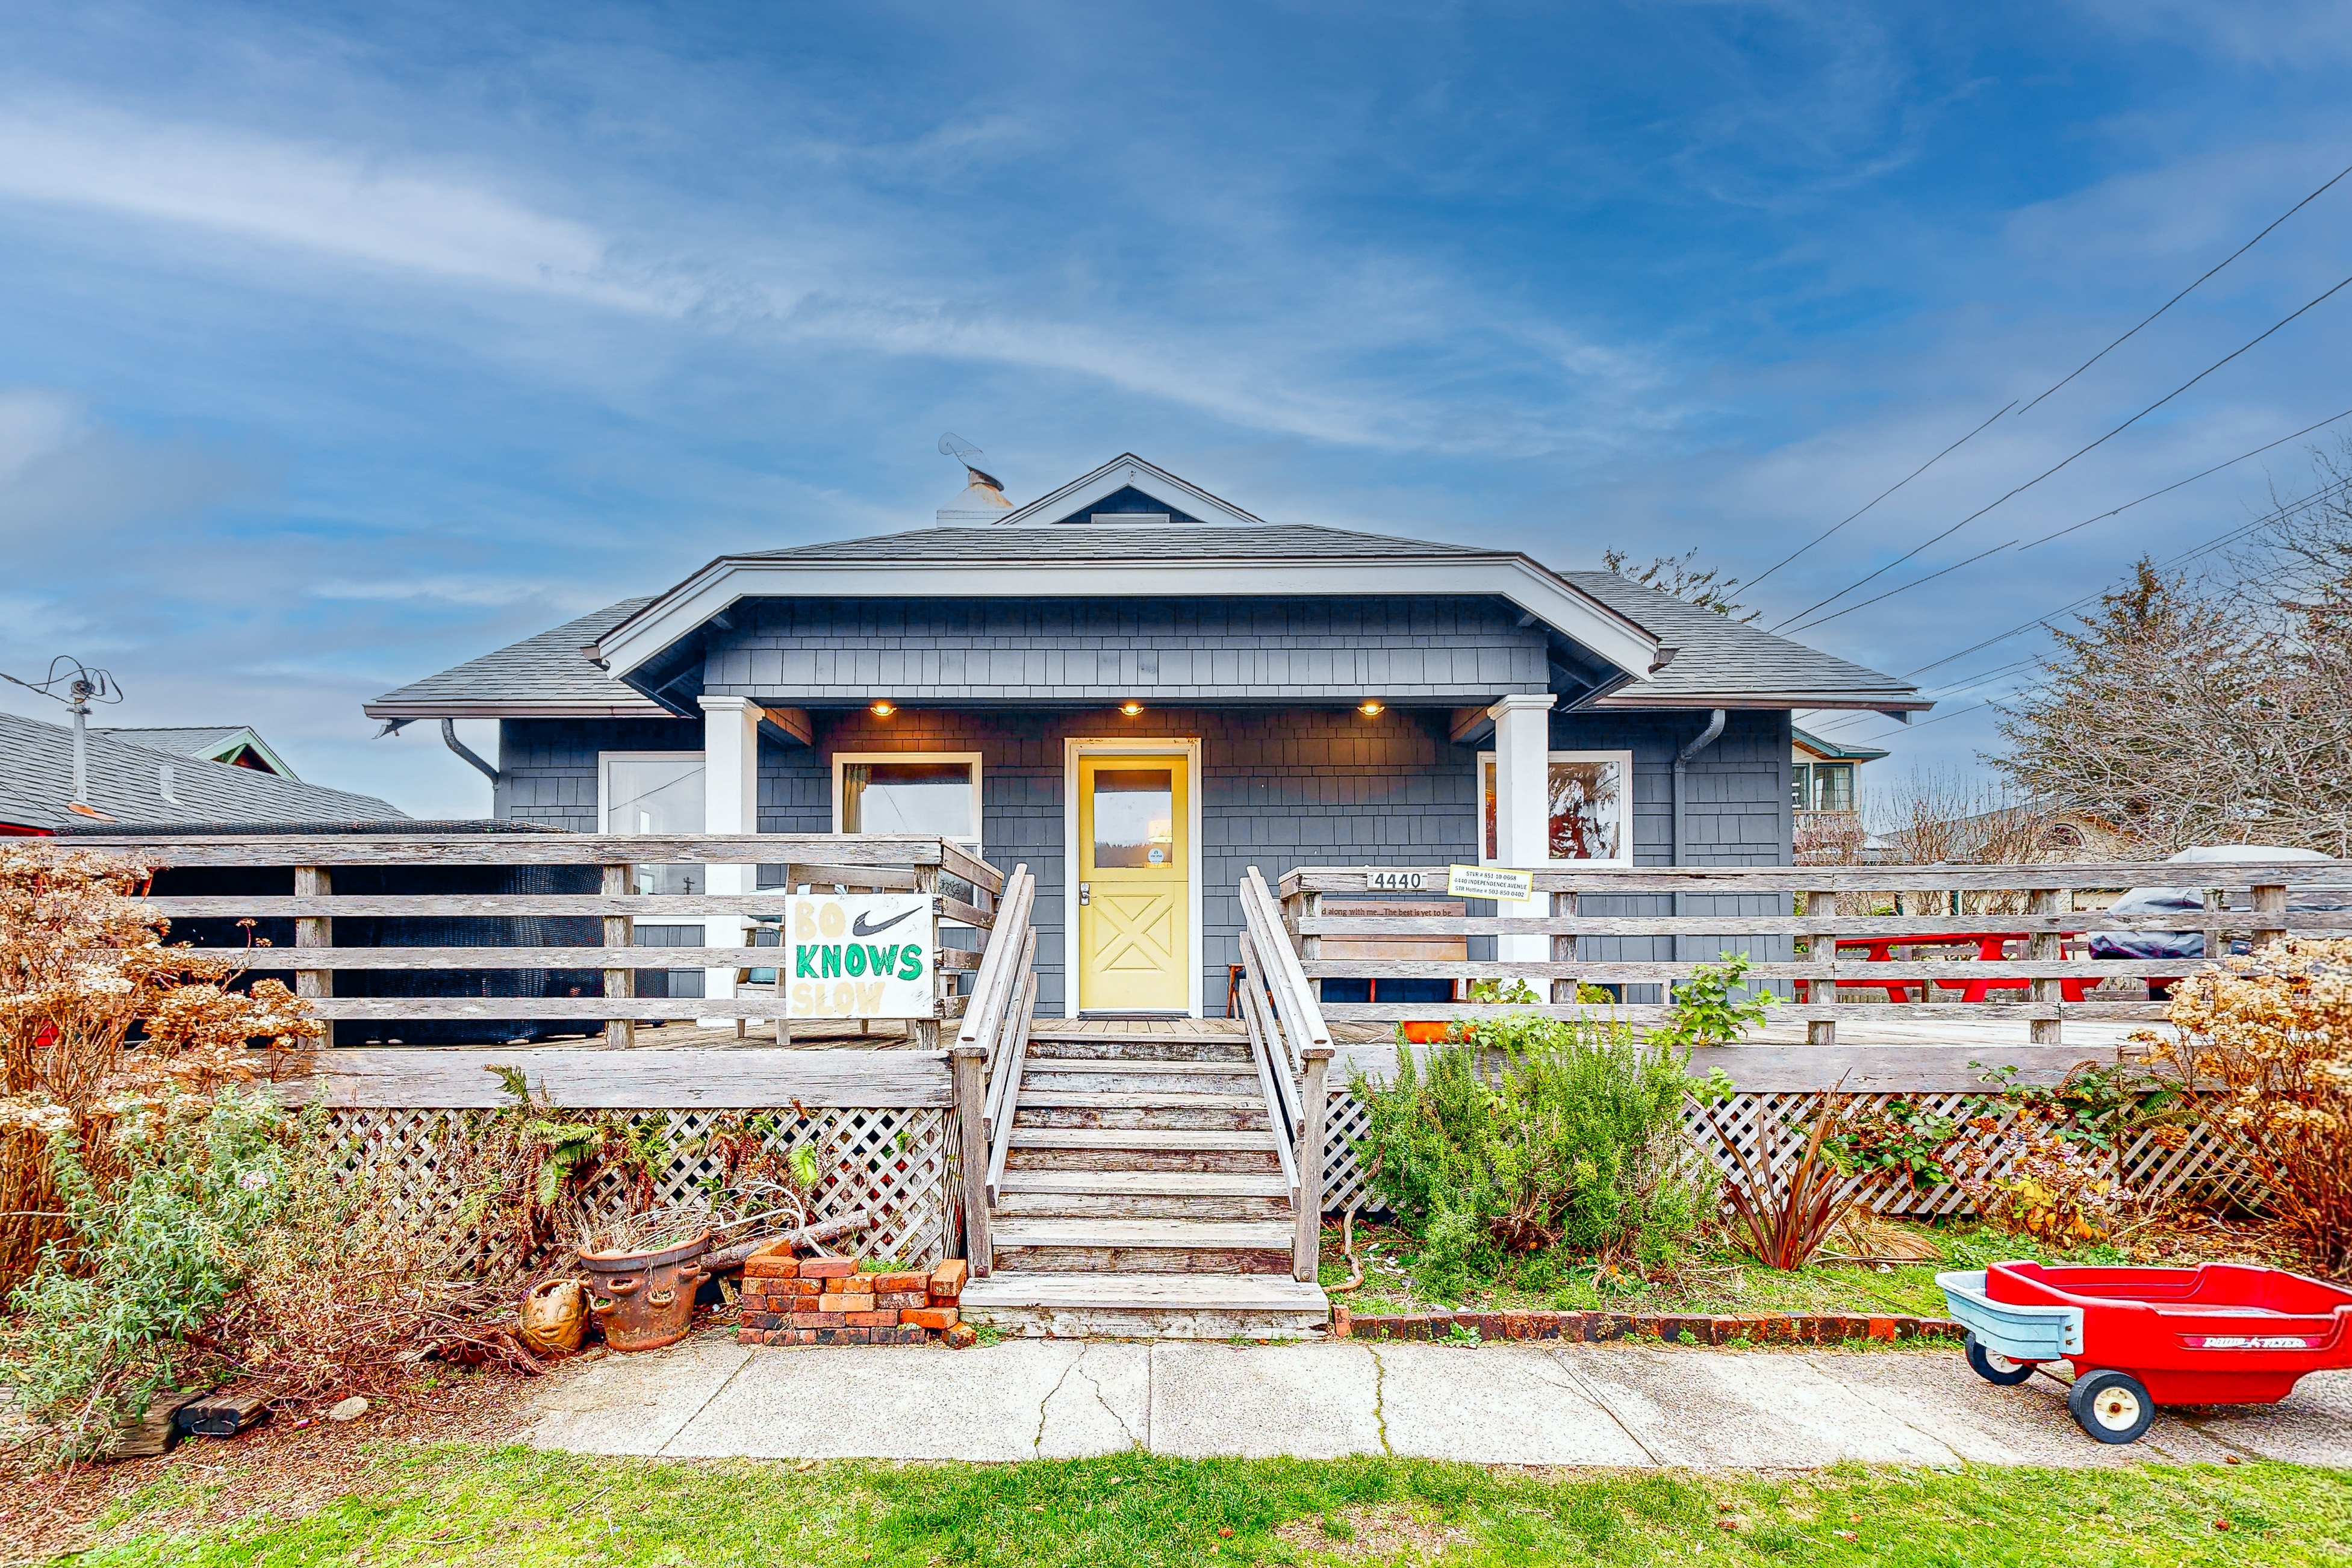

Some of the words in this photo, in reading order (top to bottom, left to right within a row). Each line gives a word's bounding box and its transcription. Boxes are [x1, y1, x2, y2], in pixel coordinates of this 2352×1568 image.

[1375, 873, 1420, 889] 4440
[795, 901, 846, 941] BO
[1328, 908, 1347, 916] along
[796, 944, 922, 980] KNOWS
[791, 982, 886, 1016] SLOW
